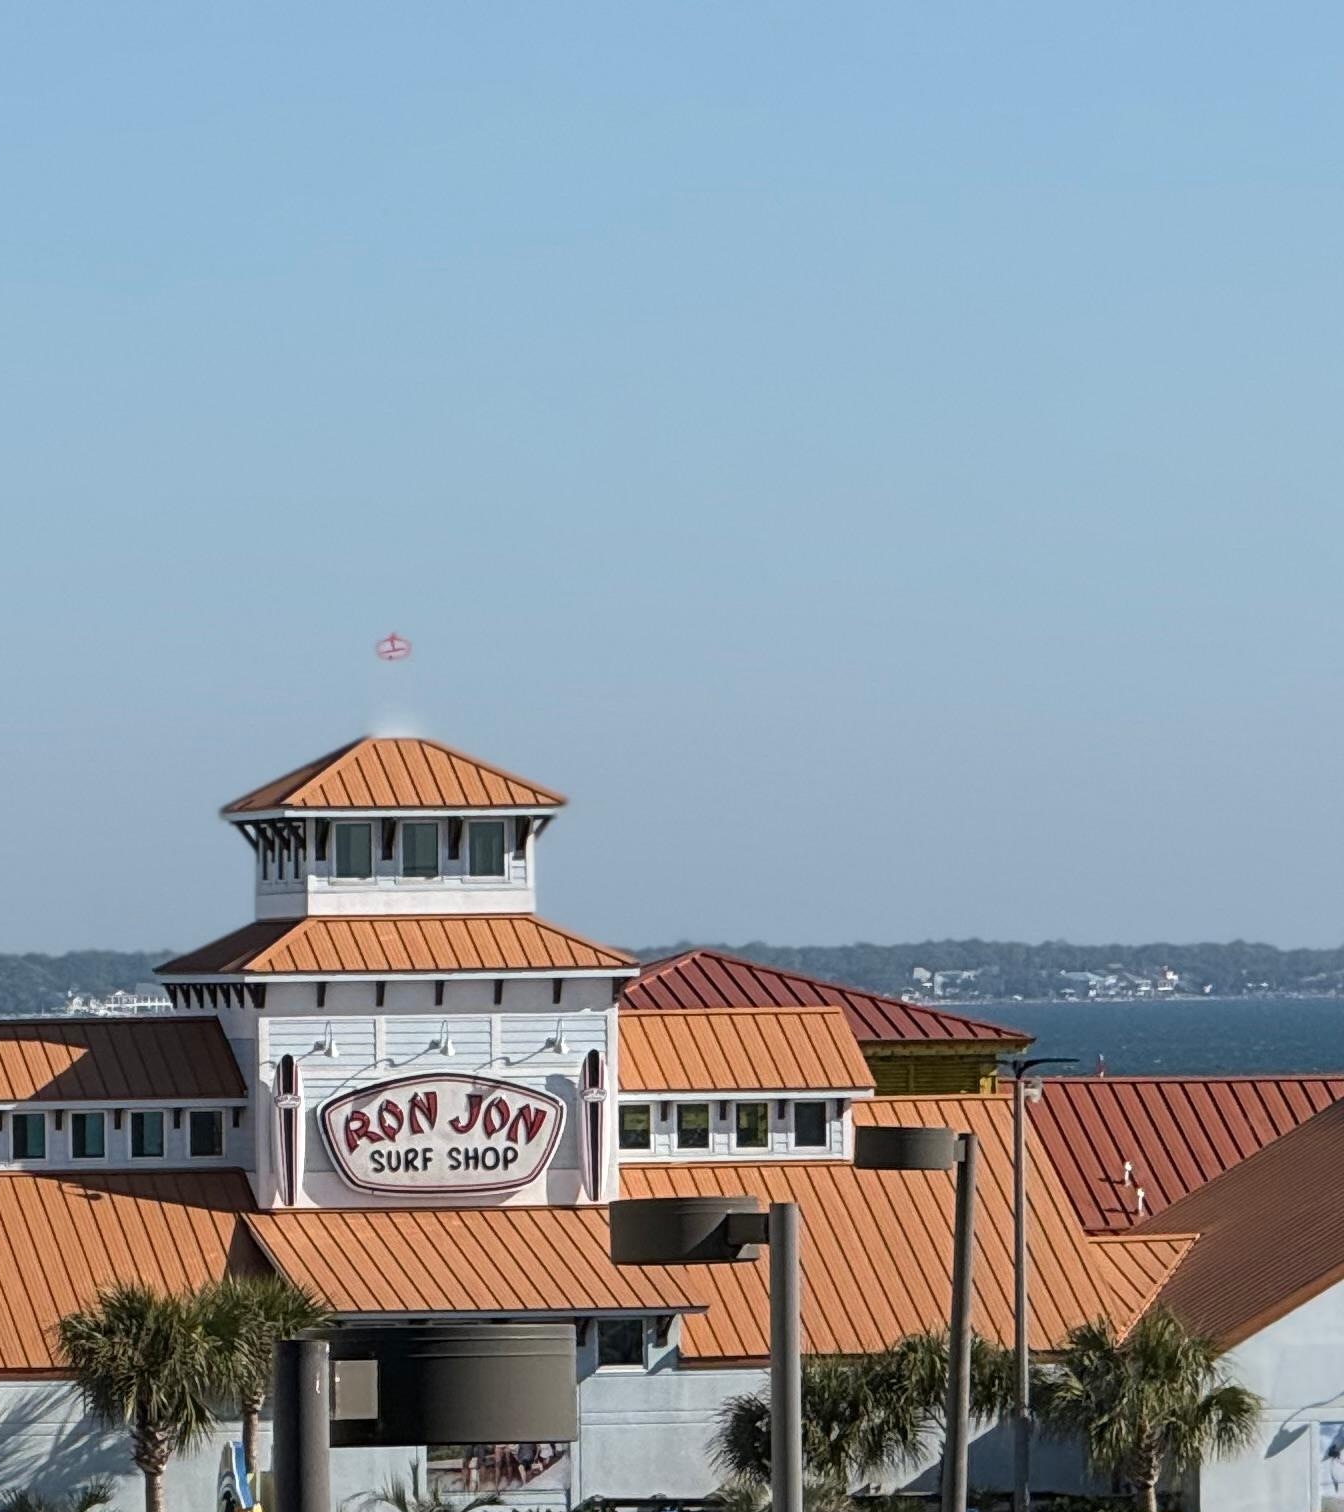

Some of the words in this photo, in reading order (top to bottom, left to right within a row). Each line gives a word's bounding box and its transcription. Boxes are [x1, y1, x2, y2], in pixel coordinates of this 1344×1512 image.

[345, 1091, 439, 1153] RON
[449, 1093, 547, 1145] JON
[370, 1148, 434, 1173] SURF
[447, 1146, 519, 1171] SHOP
